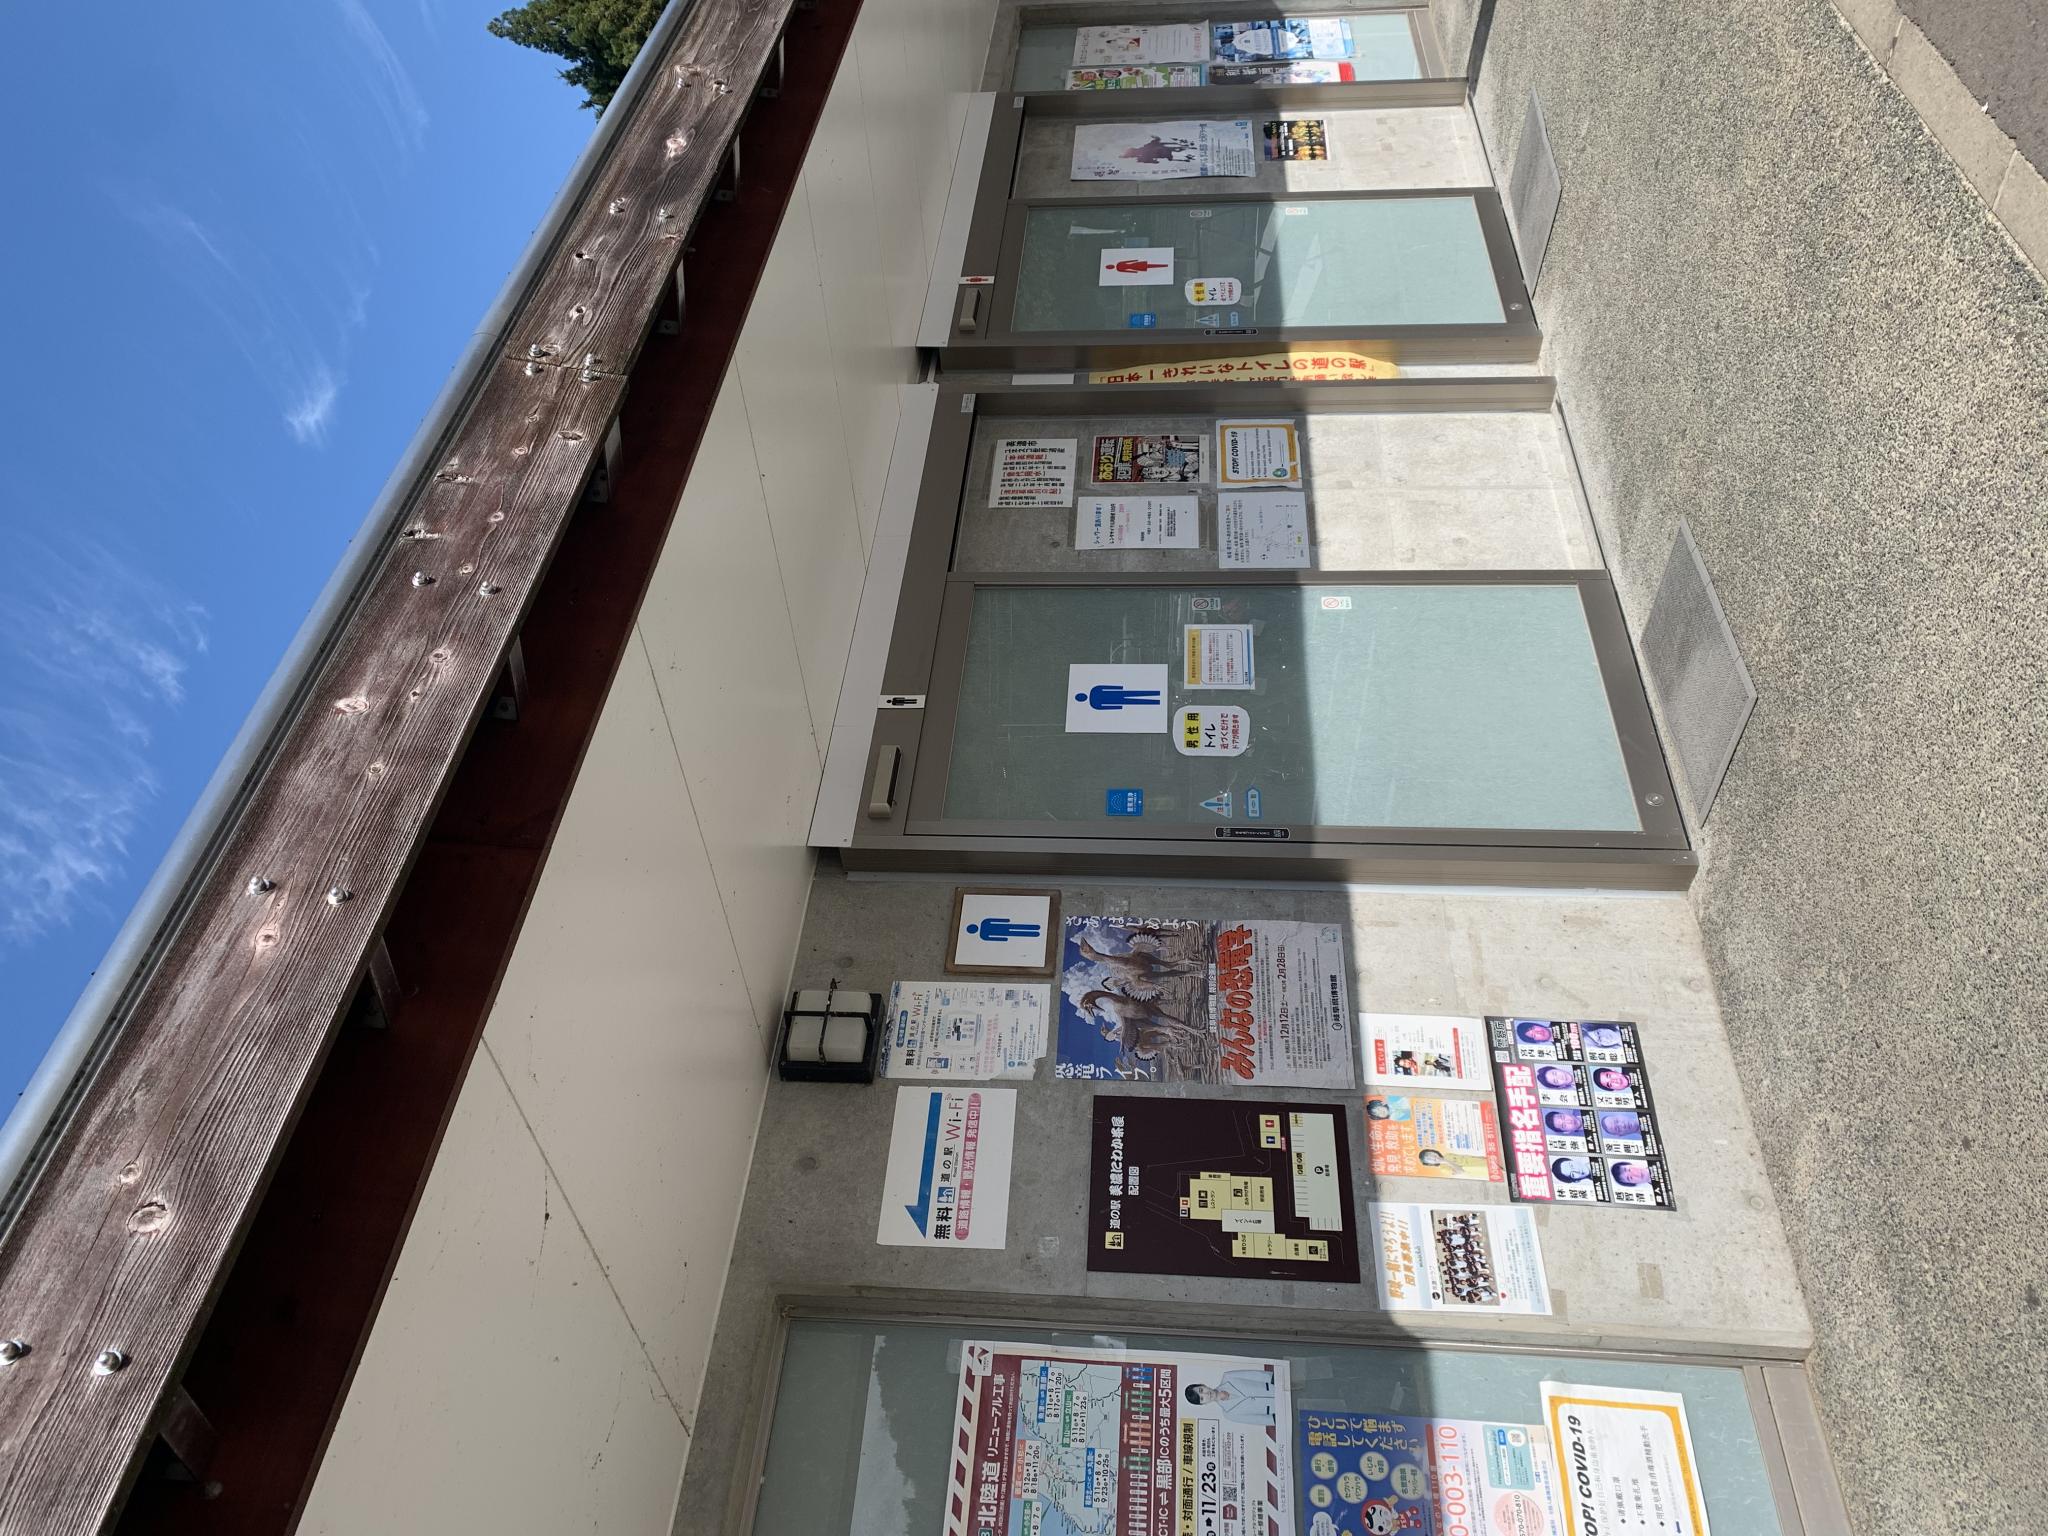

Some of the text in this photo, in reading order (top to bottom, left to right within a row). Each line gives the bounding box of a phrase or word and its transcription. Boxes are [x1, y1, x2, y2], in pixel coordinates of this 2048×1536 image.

[1098, 439, 1115, 480] あおり運転
[1231, 431, 1240, 474] STOP! COVID-19
[1186, 712, 1200, 748] 男性用
[1204, 724, 1216, 748] トイレ
[1220, 713, 1229, 750] 近づくだけで
[1066, 915, 1200, 930] さあ、はじめよう
[1217, 924, 1256, 1080] みんなの恐竜学
[1330, 974, 1340, 1022] 岐阜県博物館
[904, 1049, 915, 1066] 無料
[912, 993, 923, 1017] Wi-Fi
[1055, 1062, 1157, 1080] 恐竜ライフ。
[1504, 1065, 1550, 1198] 重要指名手配
[934, 1098, 964, 1239] 無料 道の駅 Wi-Fi
[958, 1142, 976, 1230] 道路情報・観光情報
[1109, 1116, 1125, 1229] 道の駅 美濃にわか茶屋
[1128, 1166, 1140, 1196] 配置図
[986, 1374, 1006, 1457] リニューアル工事
[1308, 1416, 1407, 1433] ひとりで悩まず
[1308, 1432, 1419, 1451] 電話してください
[1568, 1416, 1592, 1498] COVID-19
[977, 1461, 1000, 1527] 北陸道
